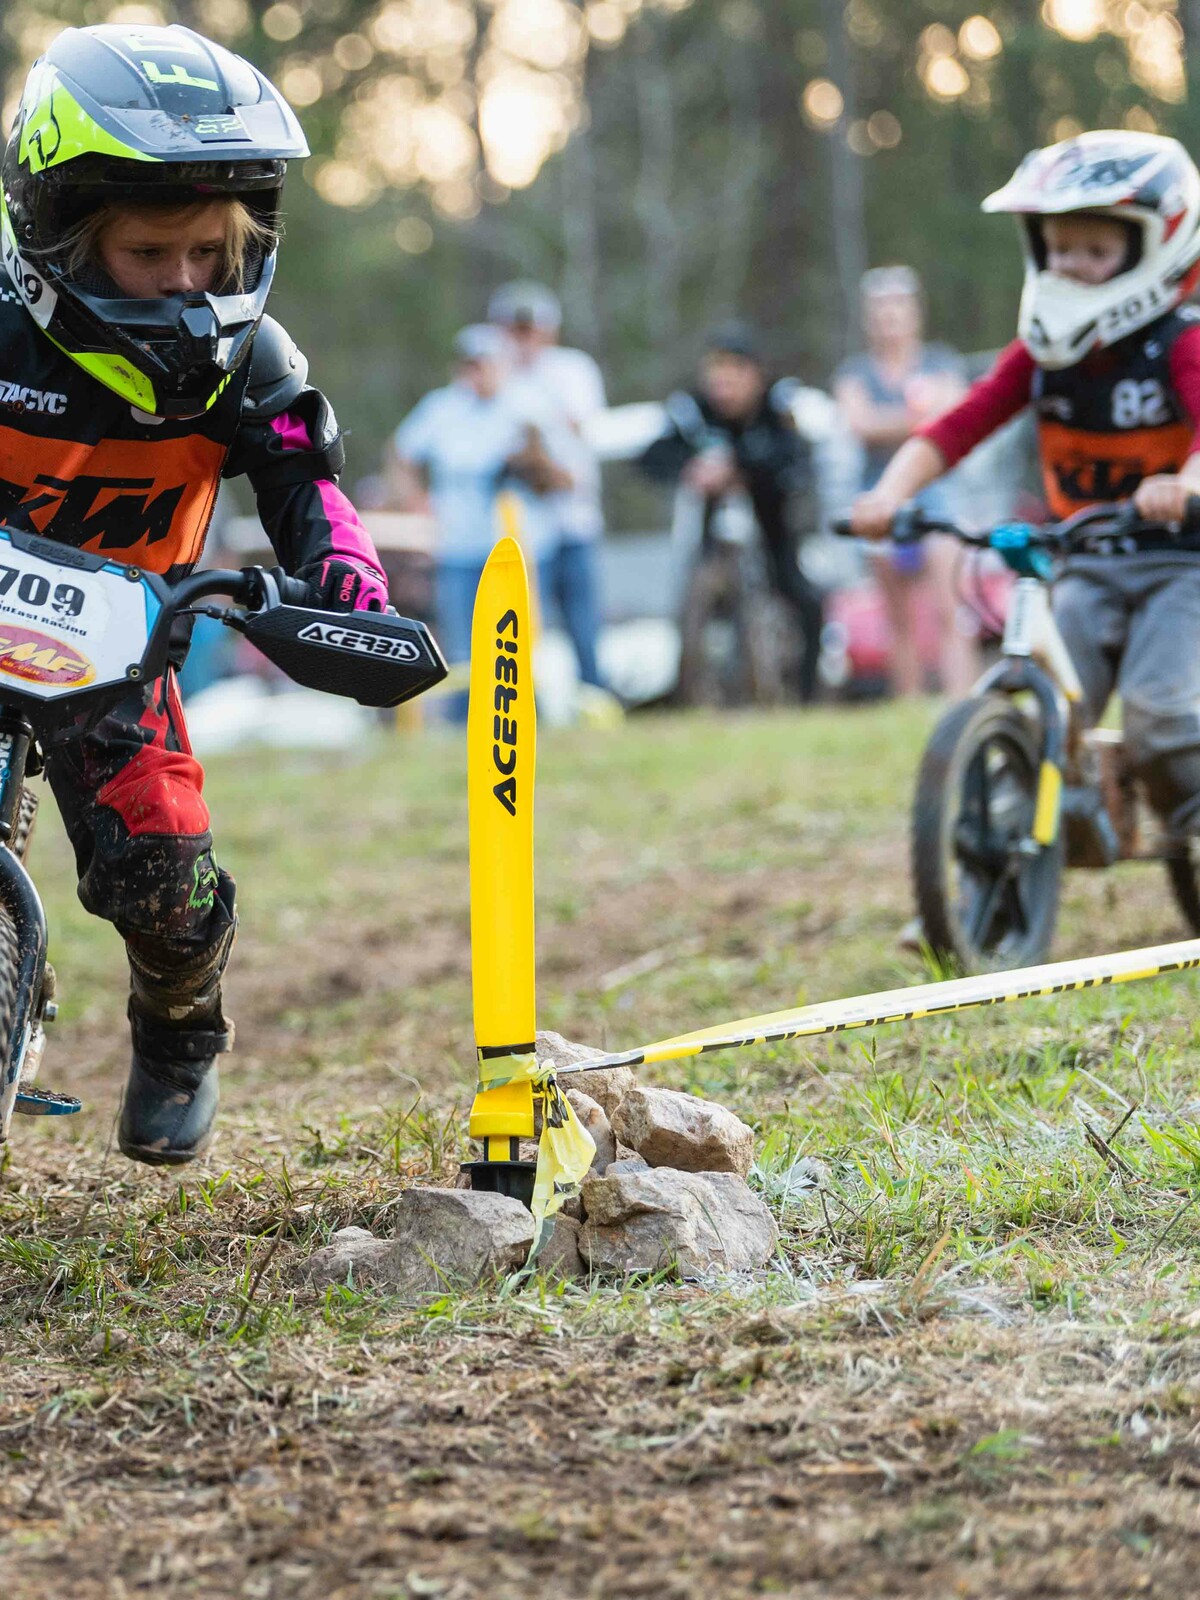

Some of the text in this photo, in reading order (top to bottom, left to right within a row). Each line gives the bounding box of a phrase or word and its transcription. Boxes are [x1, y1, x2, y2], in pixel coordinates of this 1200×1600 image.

[1112, 377, 1170, 429] 82
[41, 616, 88, 637] Racing
[301, 625, 417, 661] ACERBIS
[492, 608, 519, 817] ACERBIS
